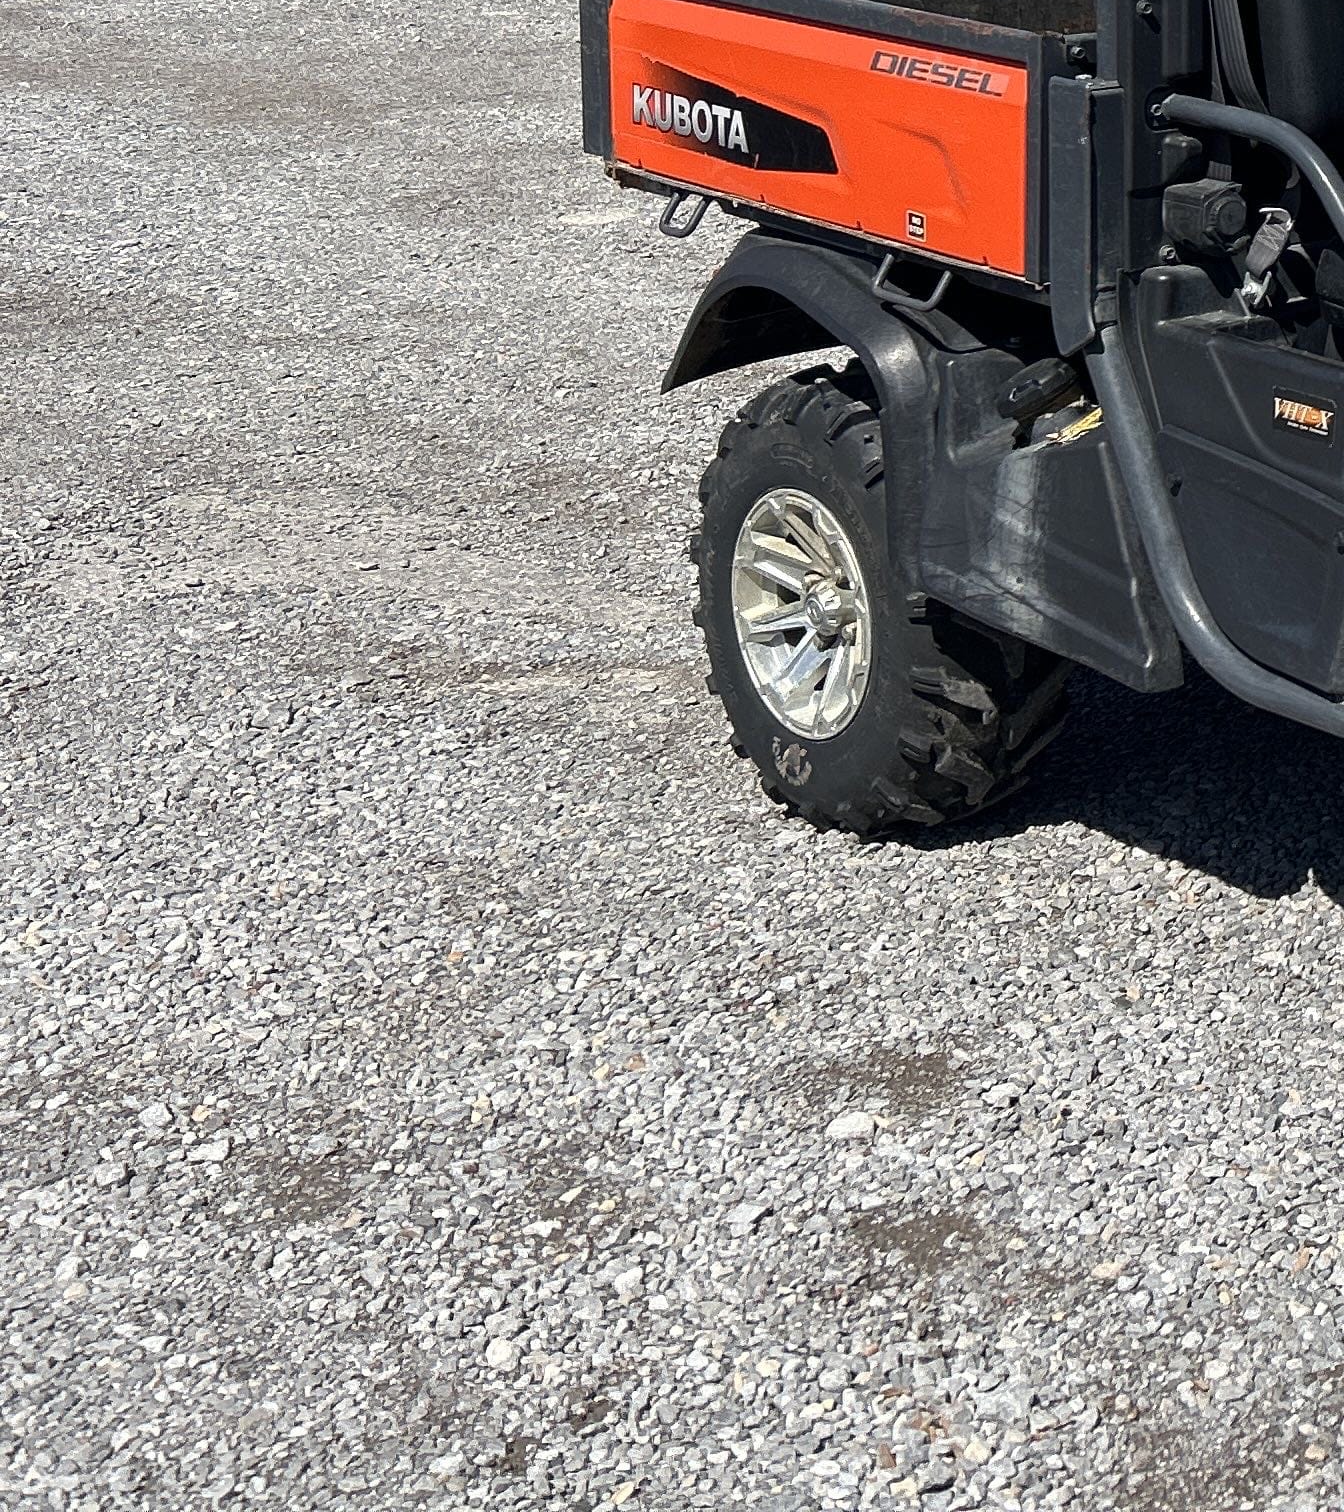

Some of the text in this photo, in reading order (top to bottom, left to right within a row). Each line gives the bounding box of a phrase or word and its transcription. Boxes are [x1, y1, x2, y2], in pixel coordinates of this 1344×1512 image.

[869, 51, 1003, 97] DIESEL
[632, 84, 749, 154] KUBOTA
[1273, 396, 1335, 431] VHT-X
